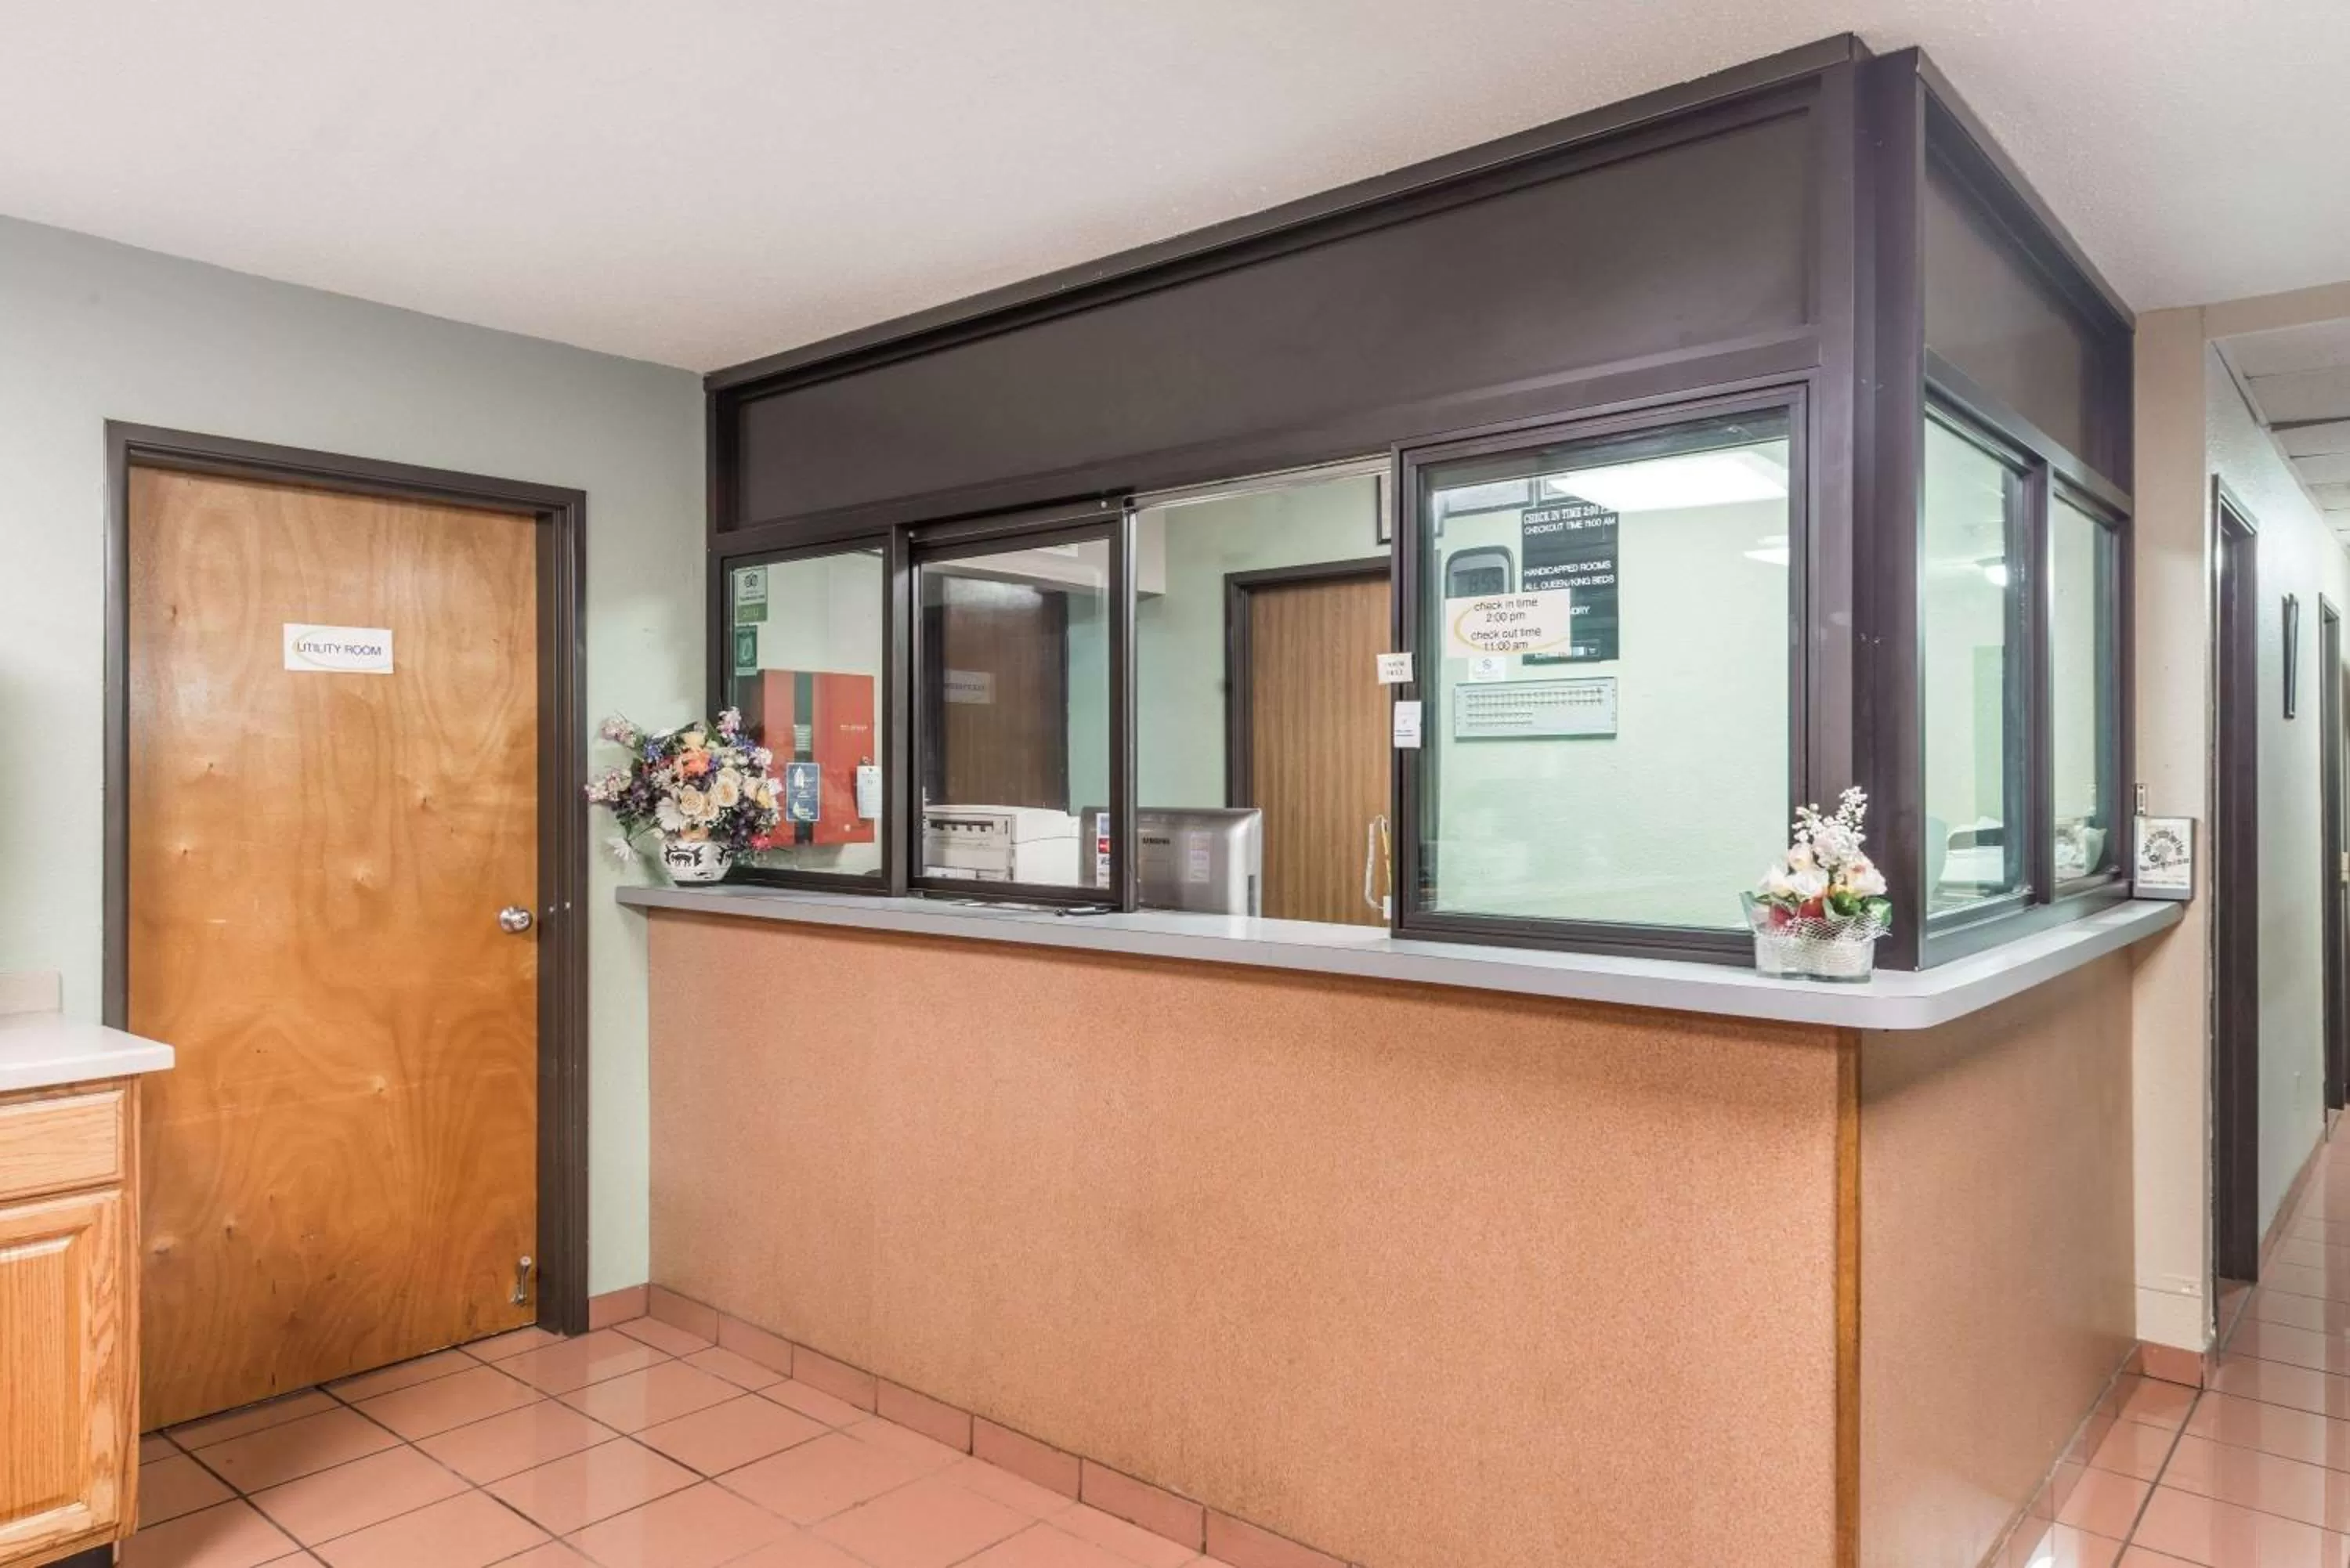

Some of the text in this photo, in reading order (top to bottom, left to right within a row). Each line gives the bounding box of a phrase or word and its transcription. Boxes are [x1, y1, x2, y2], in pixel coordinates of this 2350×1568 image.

[1524, 511, 1550, 524] CHECK
[1551, 510, 1560, 521] IN
[1562, 507, 1582, 518] TIME
[1524, 522, 1564, 535] CHECKOUT
[1567, 519, 1583, 530] TIME
[1603, 516, 1616, 526] AM
[1524, 560, 1612, 577] HANDICAPPED ROOMS
[1524, 574, 1614, 591] ALL QUEEN/KING BEDS
[1473, 597, 1539, 612] check in time
[1486, 611, 1527, 623] 2:00 pm
[1470, 627, 1542, 641] check out time
[296, 641, 382, 656] UTILITY ROOM
[1484, 641, 1529, 652] 11:00 am
